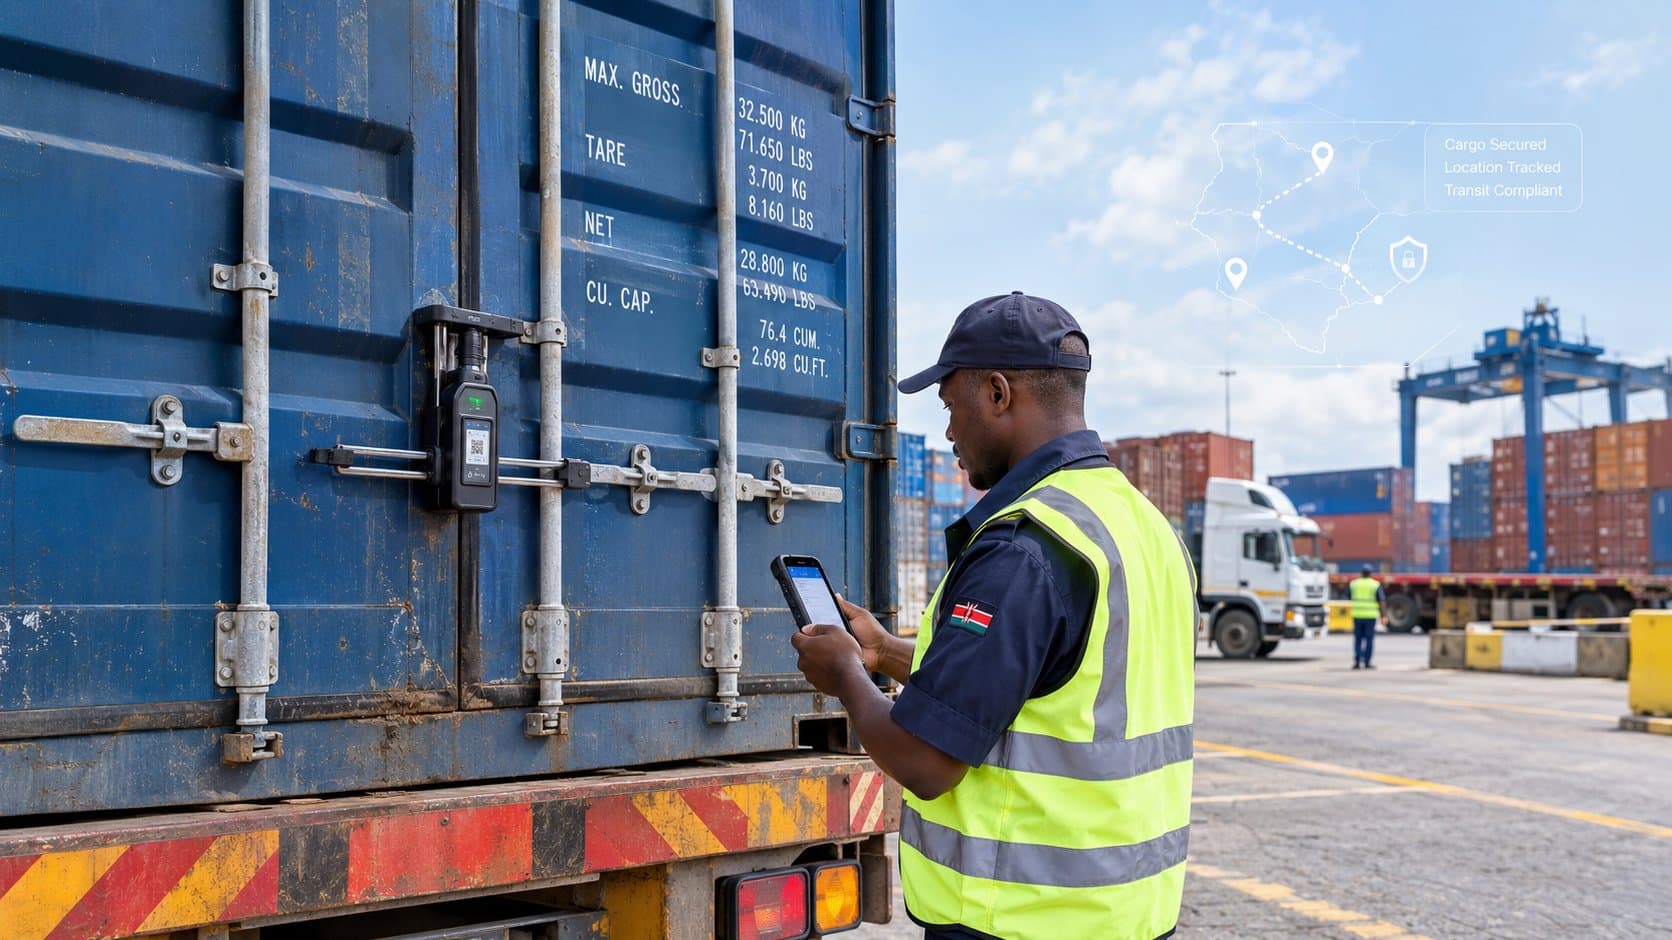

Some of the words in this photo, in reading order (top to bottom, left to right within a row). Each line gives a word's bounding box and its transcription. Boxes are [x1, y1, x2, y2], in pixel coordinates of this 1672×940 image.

[585, 56, 623, 90] MAX.
[738, 97, 783, 131] 32.500
[791, 115, 806, 139] KG
[585, 134, 626, 167] TARE
[739, 129, 783, 162] 71.650
[791, 148, 813, 171] LBS
[748, 165, 783, 193] 3.700
[792, 177, 807, 200] KG
[585, 211, 614, 238] NET
[748, 195, 784, 223] 8.160
[792, 207, 814, 231] LBS
[740, 249, 785, 277] 28.800
[792, 262, 807, 282] KG
[586, 280, 612, 306] CU.
[621, 288, 654, 314] CAP.
[743, 279, 786, 304] 63.490
[793, 291, 816, 311] LBS
[760, 319, 786, 343] 76.4
[793, 327, 820, 350] CUM.
[752, 346, 786, 370] 2.698
[793, 354, 828, 378] CU.FT.
